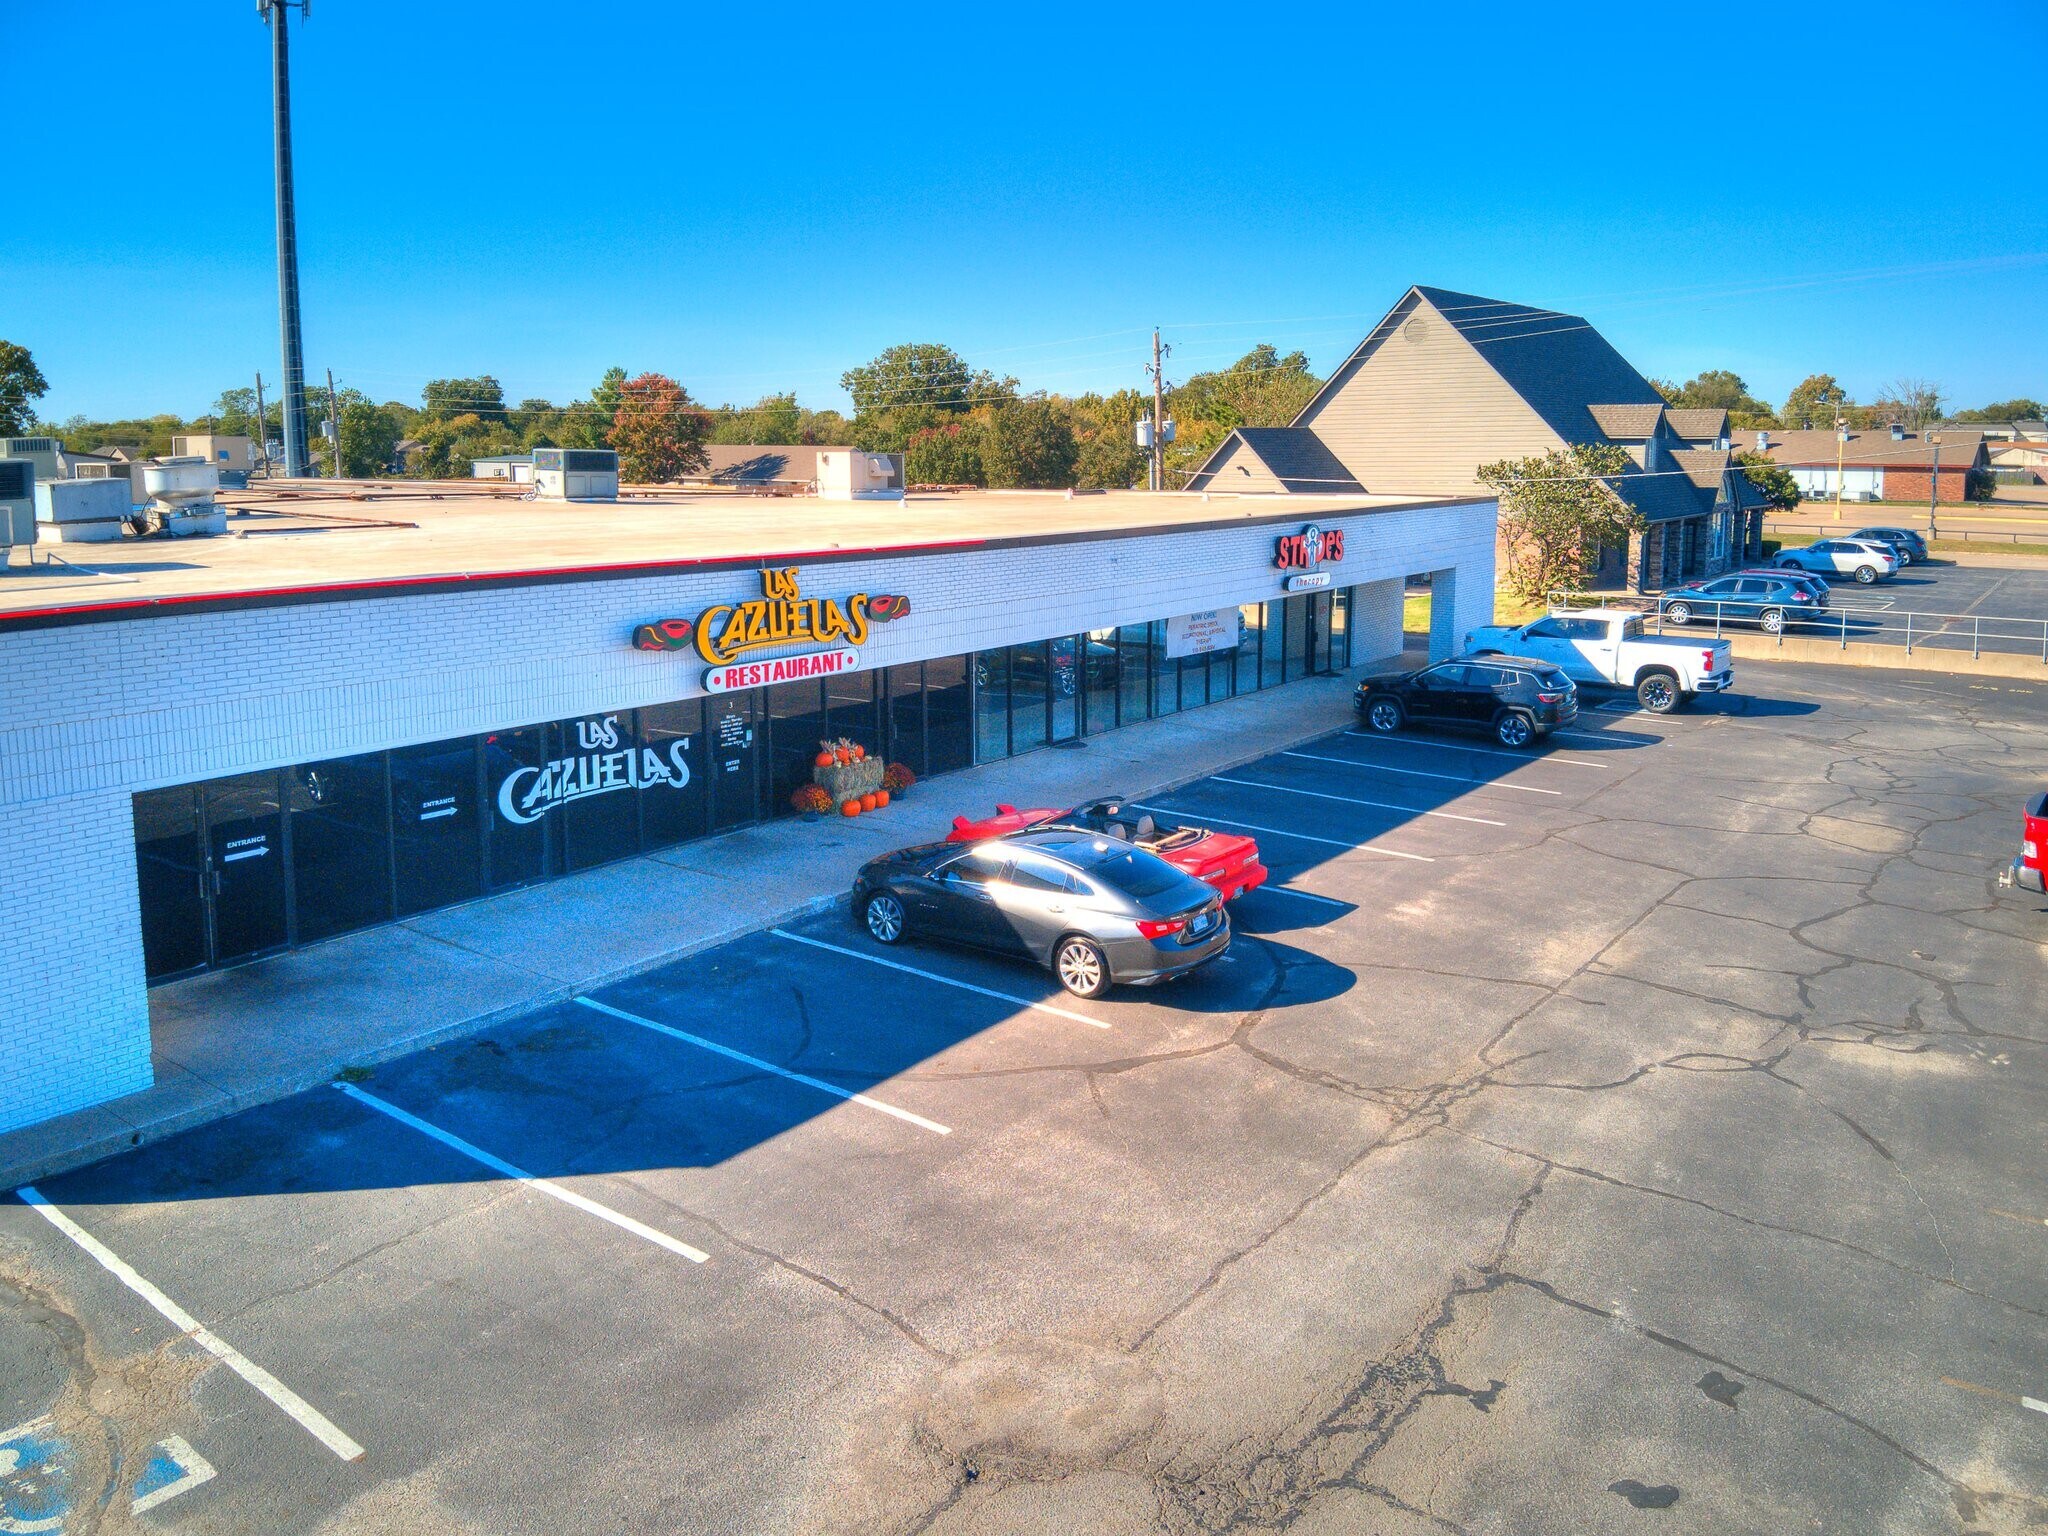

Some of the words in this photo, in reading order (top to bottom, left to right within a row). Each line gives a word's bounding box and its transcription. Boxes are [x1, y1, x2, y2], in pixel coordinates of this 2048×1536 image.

[761, 566, 800, 601] LAS
[1295, 577, 1324, 587] therapy
[695, 593, 868, 666] CAZUELAS
[725, 652, 844, 689] RESTAURANT
[576, 715, 618, 749] LAS
[498, 738, 690, 824] CAZUELAS
[422, 797, 456, 809] ENTRANCE
[226, 835, 266, 849] ENTRANCE
